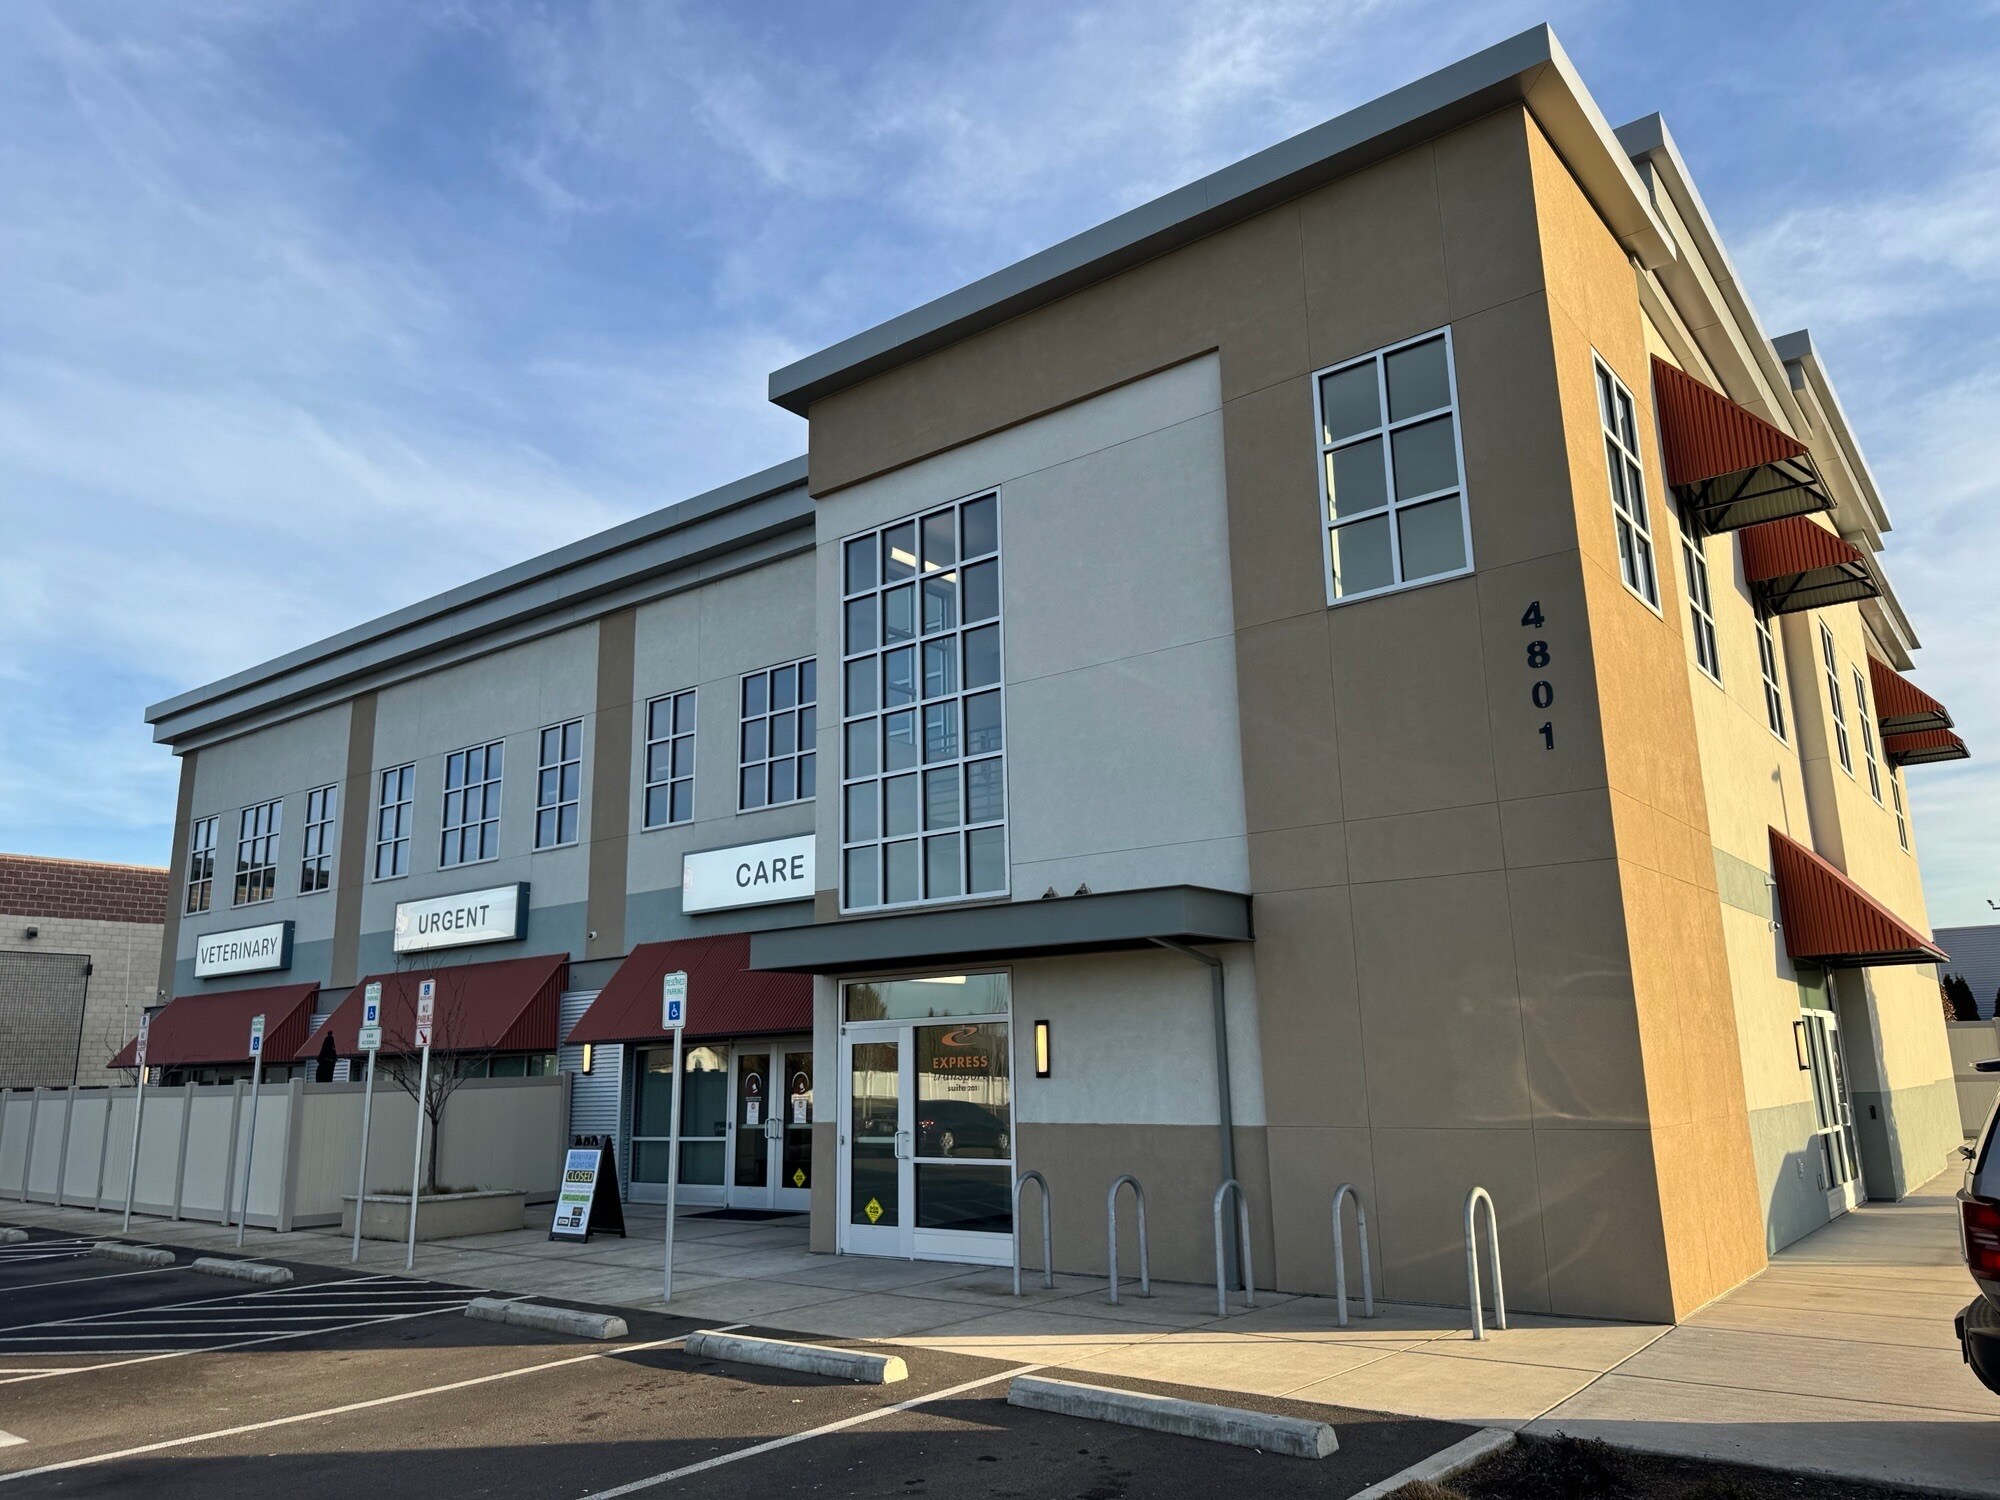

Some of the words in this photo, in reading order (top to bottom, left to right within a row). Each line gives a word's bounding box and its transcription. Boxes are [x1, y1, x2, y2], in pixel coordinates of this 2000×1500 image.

[1520, 600, 1555, 750] 4801
[736, 854, 805, 888] CARE
[418, 904, 490, 935] URGENT
[200, 936, 278, 965] VETERINARY
[933, 1055, 988, 1069] EXPRESS
[947, 1084, 967, 1092] suite
[567, 1171, 593, 1181] CLOSED
